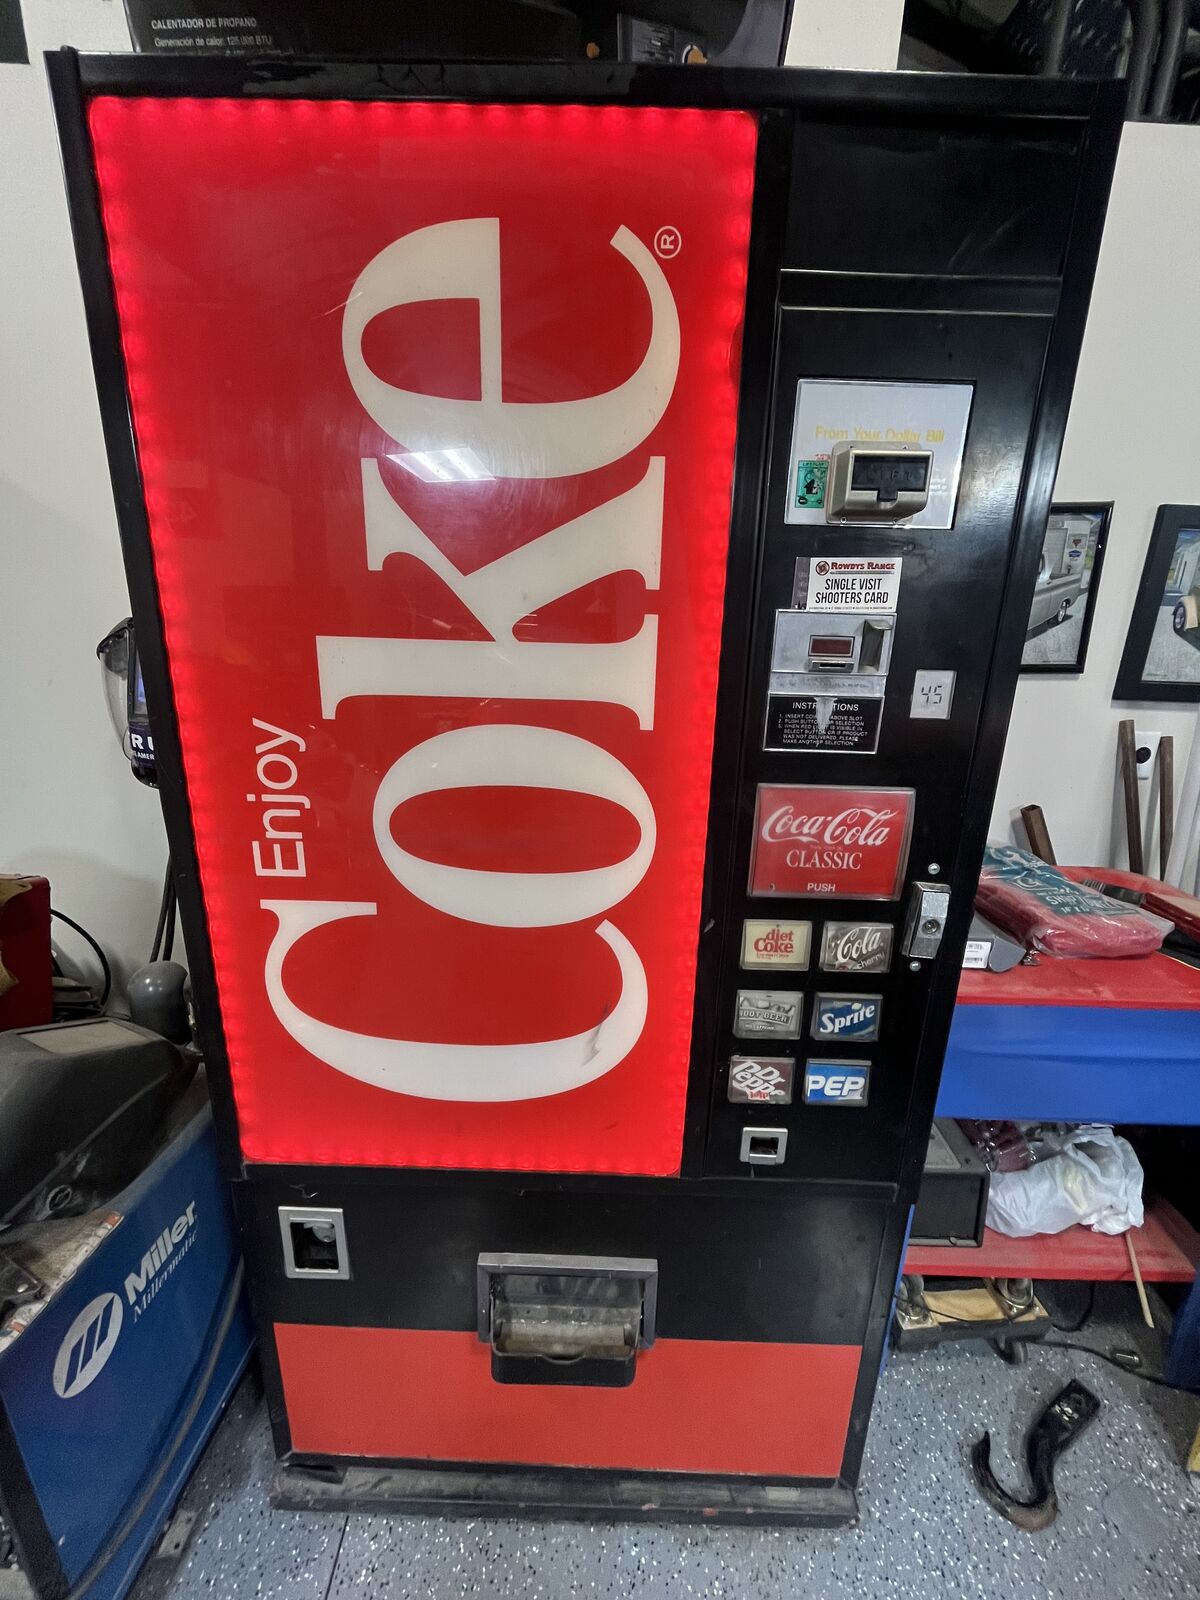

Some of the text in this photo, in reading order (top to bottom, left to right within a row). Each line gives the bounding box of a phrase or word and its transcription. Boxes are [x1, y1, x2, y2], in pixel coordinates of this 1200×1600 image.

[151, 17, 257, 30] CALENTADOR DE PROPANO
[815, 425, 848, 440] From
[854, 426, 881, 441] Your
[926, 429, 945, 442] Bill
[824, 578, 883, 590] SINGLE VISIT
[815, 591, 889, 604] SHOOTERS CARD
[259, 216, 682, 1103] Coke
[921, 685, 943, 704] 45
[792, 702, 859, 711] INSTRTIONS
[246, 718, 307, 879] Enjoy
[762, 805, 899, 846] Coca-Cola
[786, 849, 862, 870] CLASSIC
[807, 882, 836, 892] PUSH
[766, 929, 794, 943] diet
[754, 938, 794, 954] Coke
[819, 1003, 875, 1033] Sprite
[807, 1075, 865, 1097] PEP
[124, 1201, 195, 1305] Miller
[133, 1228, 197, 1325] Millermatic
